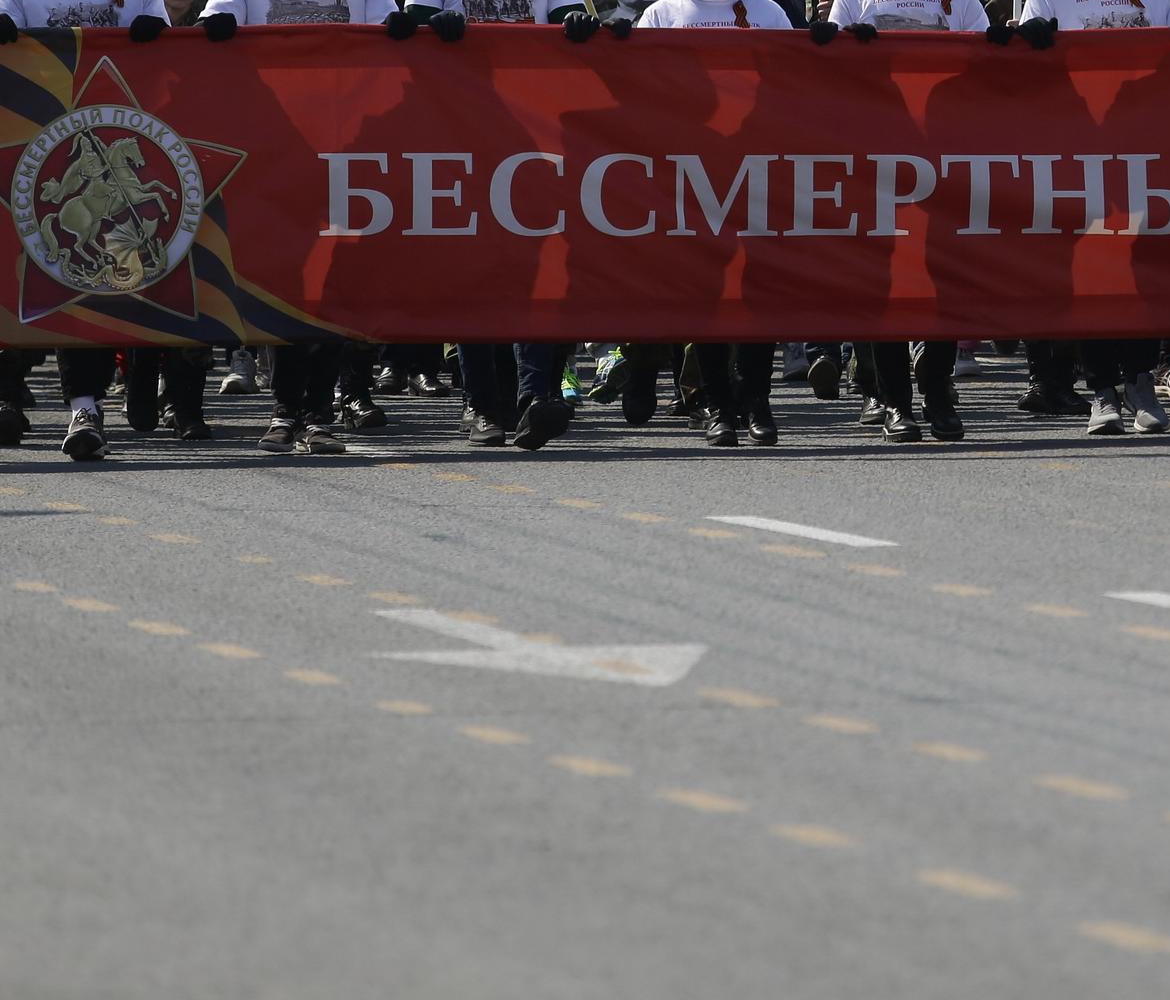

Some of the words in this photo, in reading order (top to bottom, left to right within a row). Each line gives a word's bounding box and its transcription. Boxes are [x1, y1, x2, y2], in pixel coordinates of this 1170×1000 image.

[16, 108, 104, 237] БЕССМЕРТНЫЙ
[112, 108, 170, 144] ПОЛК
[167, 141, 201, 234] РОССИИ
